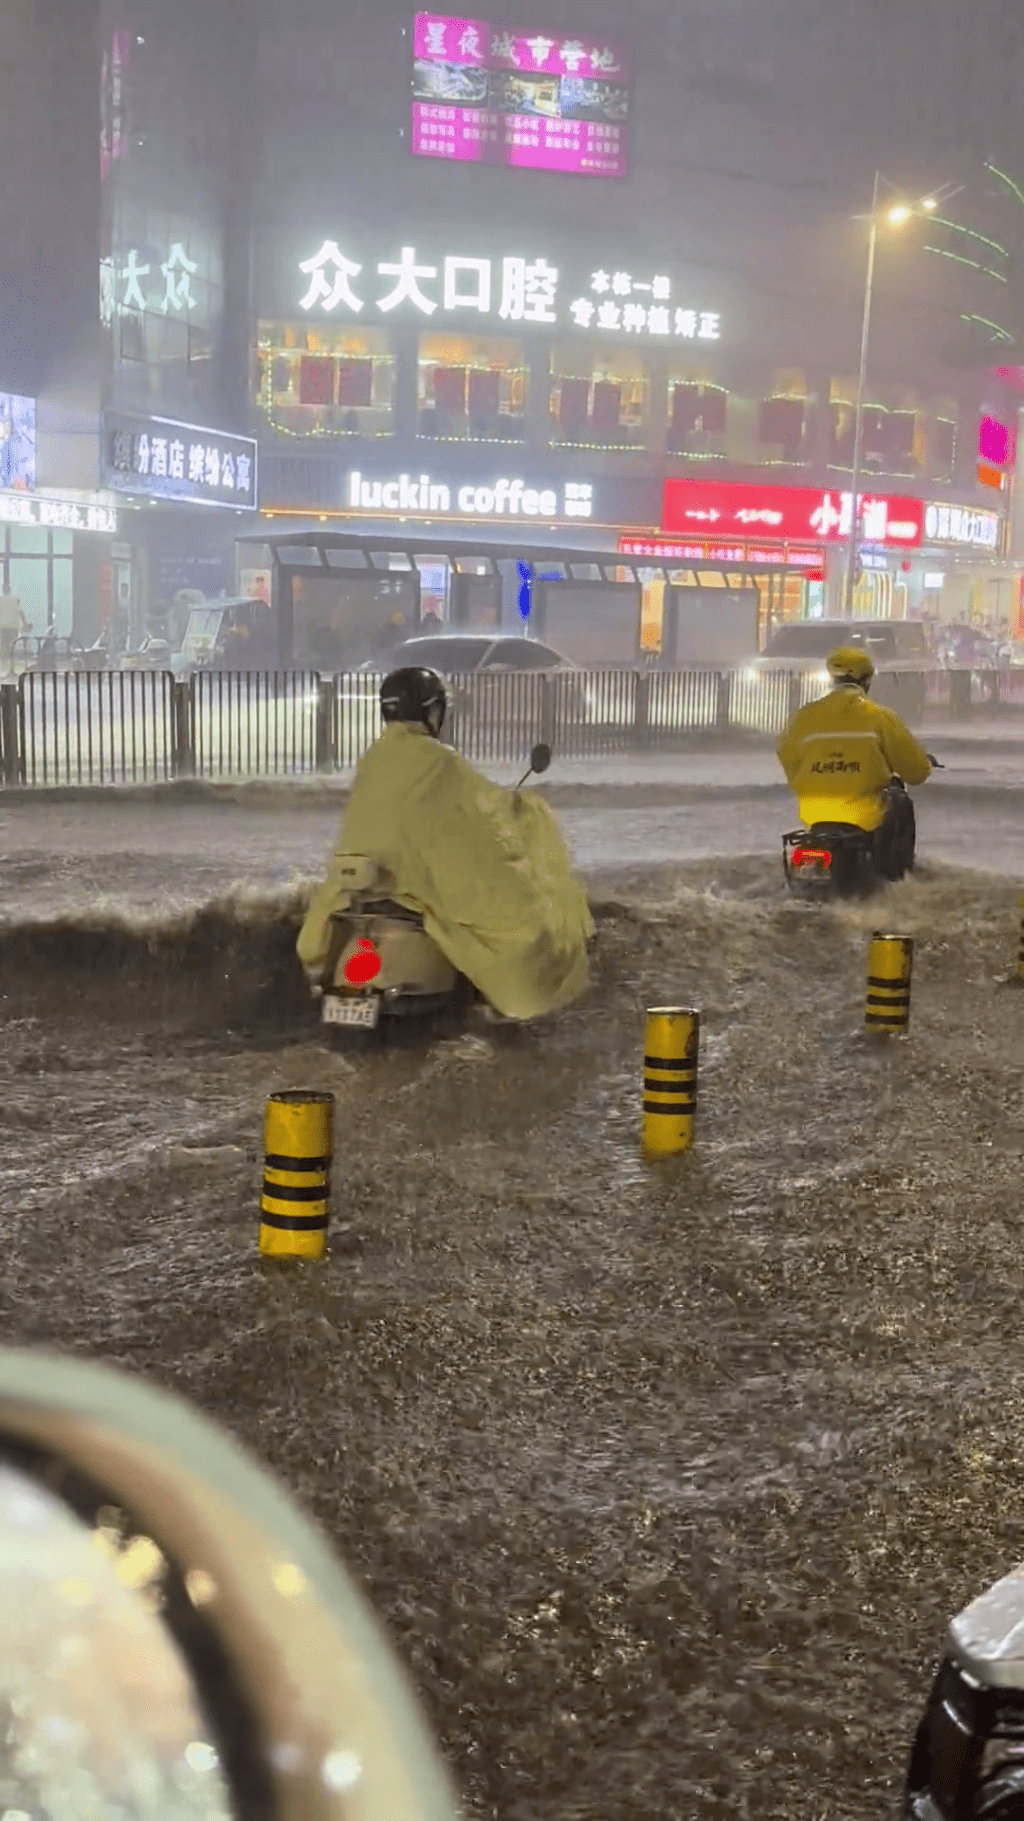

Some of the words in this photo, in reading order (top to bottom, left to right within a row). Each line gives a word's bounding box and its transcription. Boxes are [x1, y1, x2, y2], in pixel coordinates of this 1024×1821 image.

[298, 239, 558, 323] 众大口腔
[569, 296, 670, 334] 专业种植
[674, 307, 720, 339] 矫正
[350, 471, 450, 511] luckin
[458, 478, 557, 516] coffee
